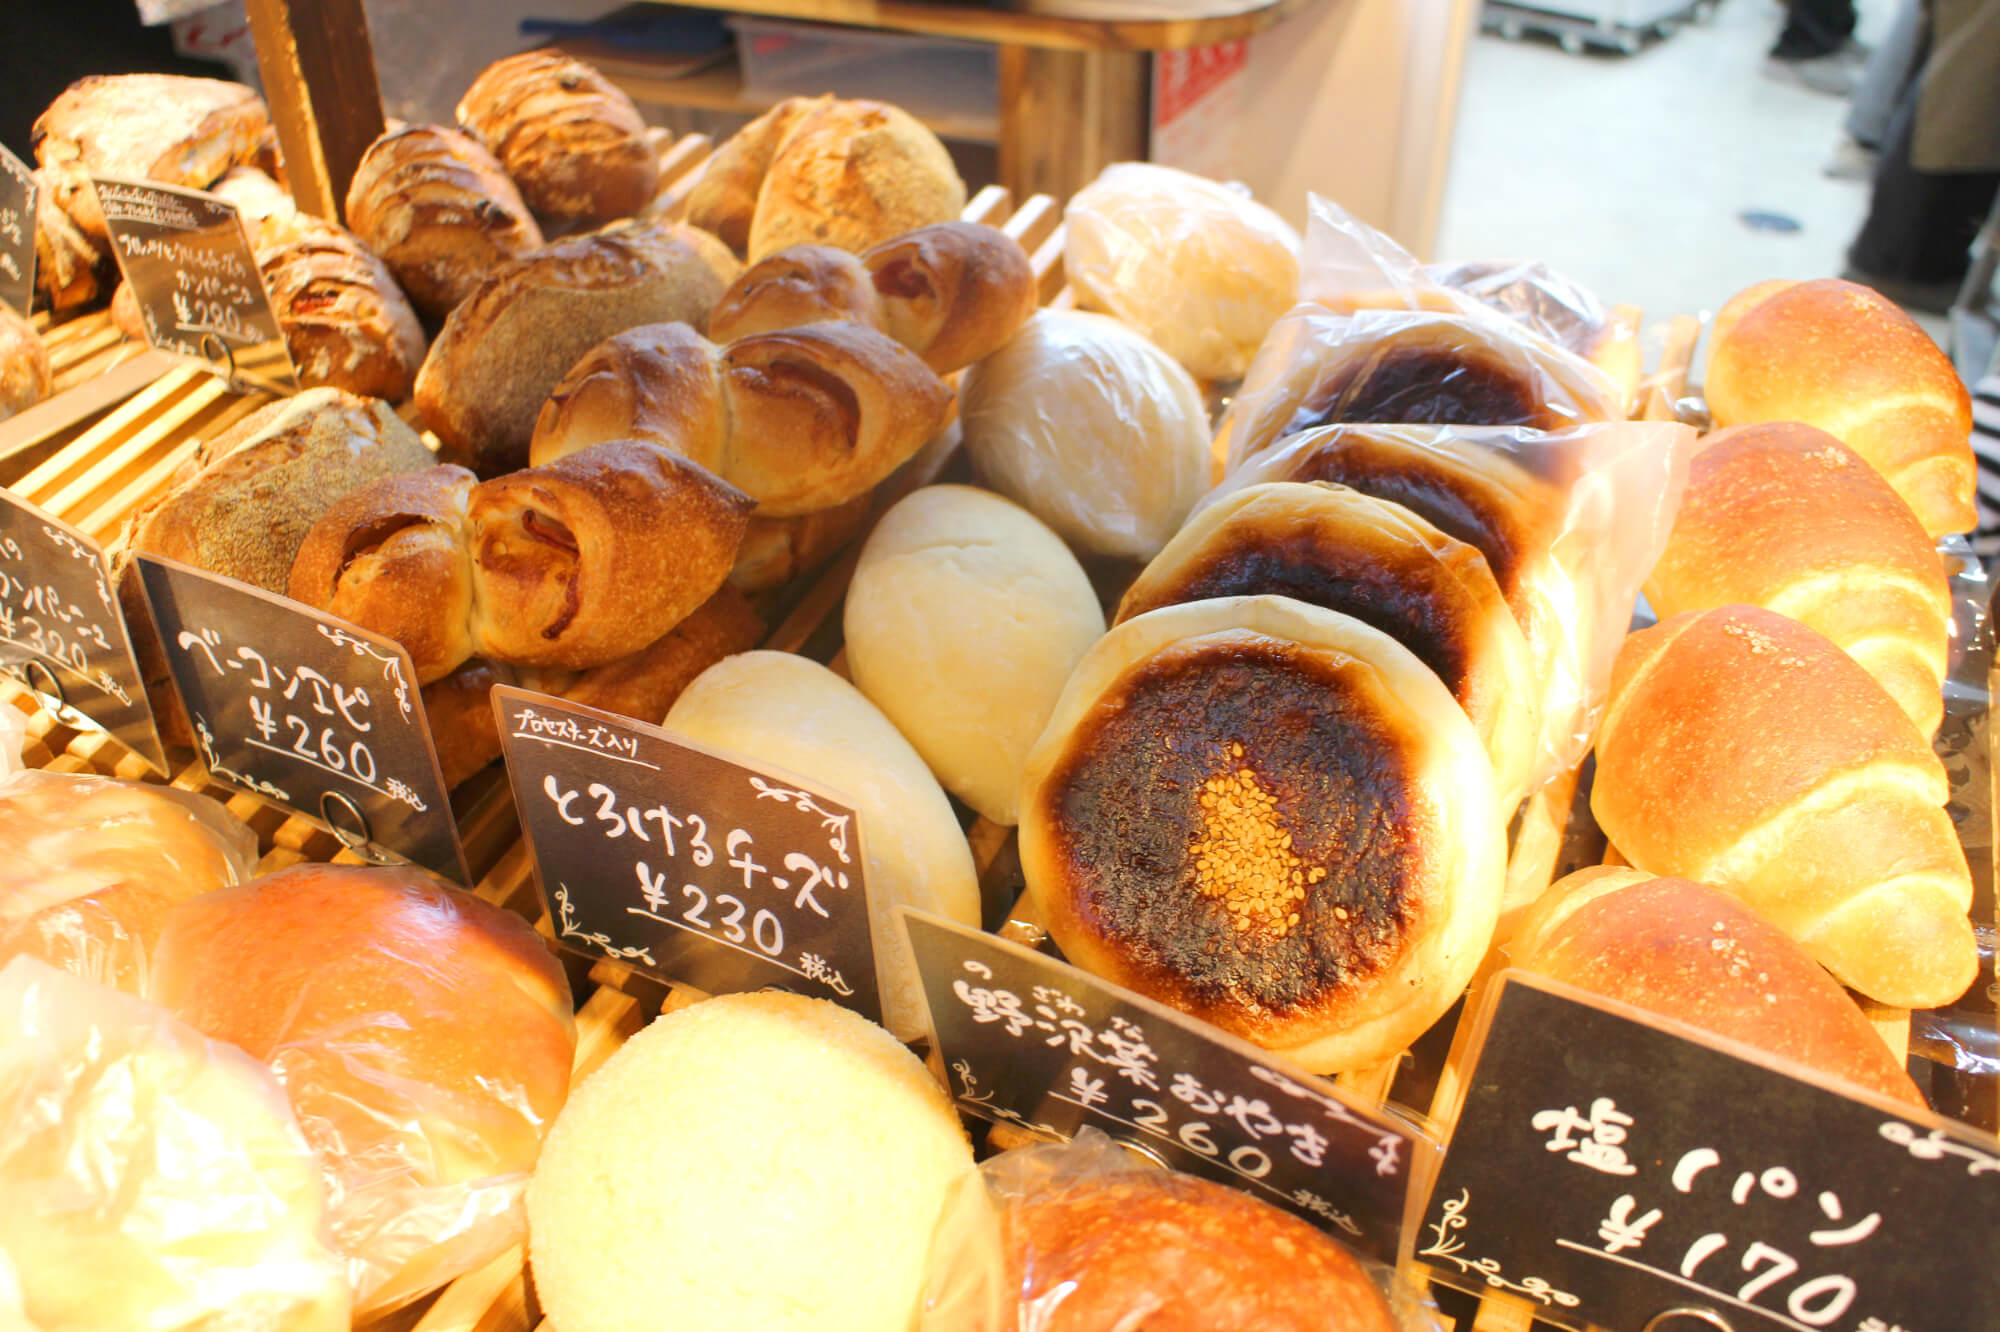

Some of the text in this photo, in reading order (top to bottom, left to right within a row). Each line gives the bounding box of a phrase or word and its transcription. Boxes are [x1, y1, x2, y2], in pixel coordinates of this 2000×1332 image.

[173, 290, 241, 333] ¥280
[178, 628, 371, 731] ベーコンエピ
[514, 709, 638, 757] プロセスチーズ入り
[250, 696, 377, 783] ¥260
[544, 775, 850, 918] とろけるチーズ
[635, 861, 854, 996] ¥230 税込
[1069, 1066, 1272, 1179] ¥260
[1598, 1194, 1857, 1326] ¥170
